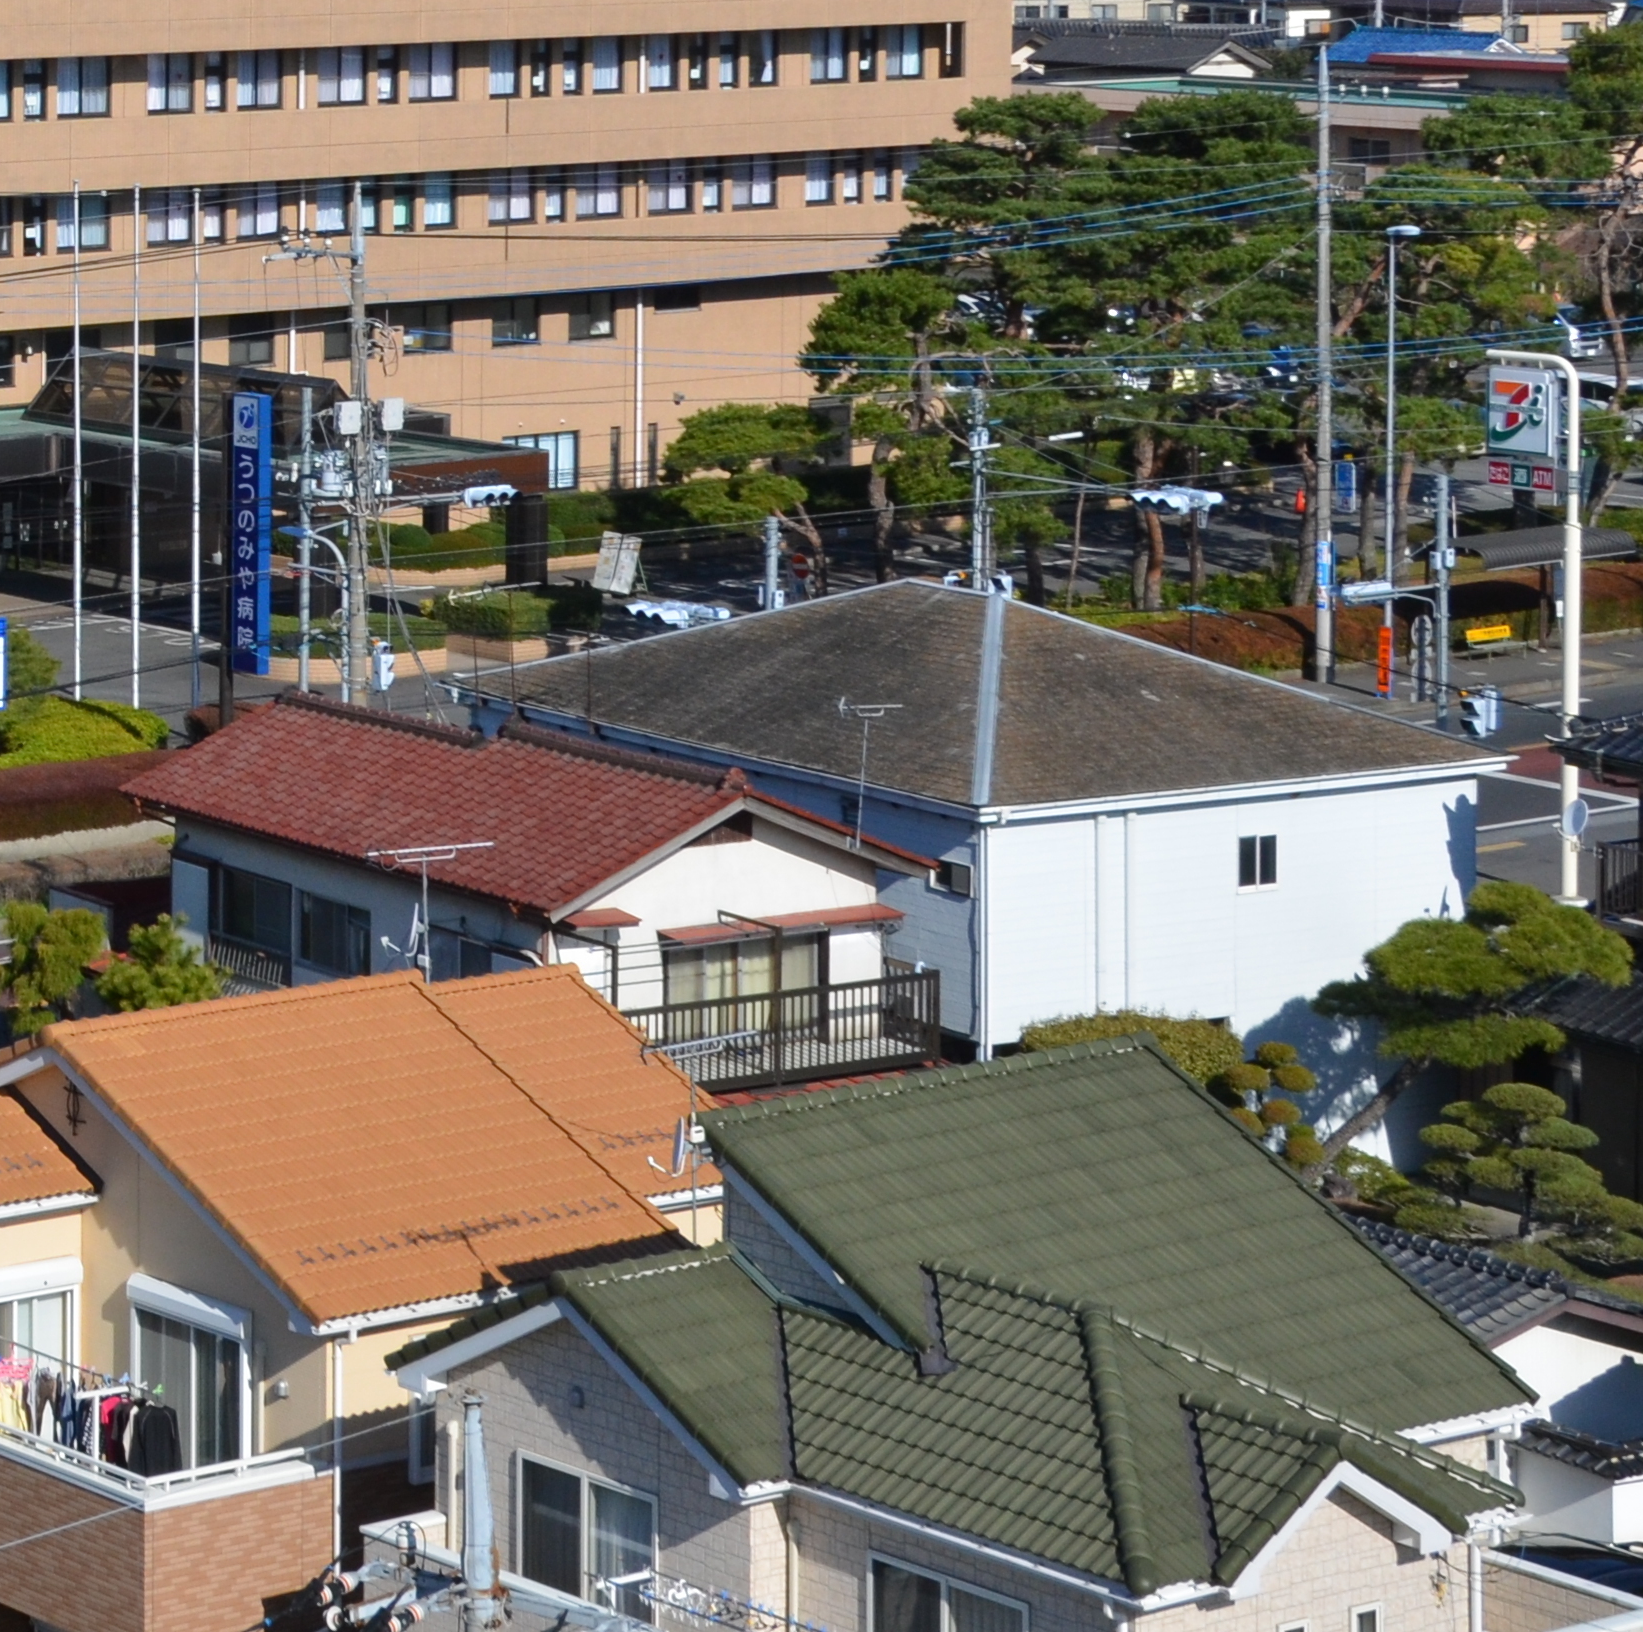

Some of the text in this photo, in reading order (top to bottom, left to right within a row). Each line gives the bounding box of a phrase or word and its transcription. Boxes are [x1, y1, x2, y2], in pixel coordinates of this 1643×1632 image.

[237, 434, 256, 446] JCHO
[1533, 470, 1552, 486] ATM
[237, 453, 256, 649] うつのみや病院
